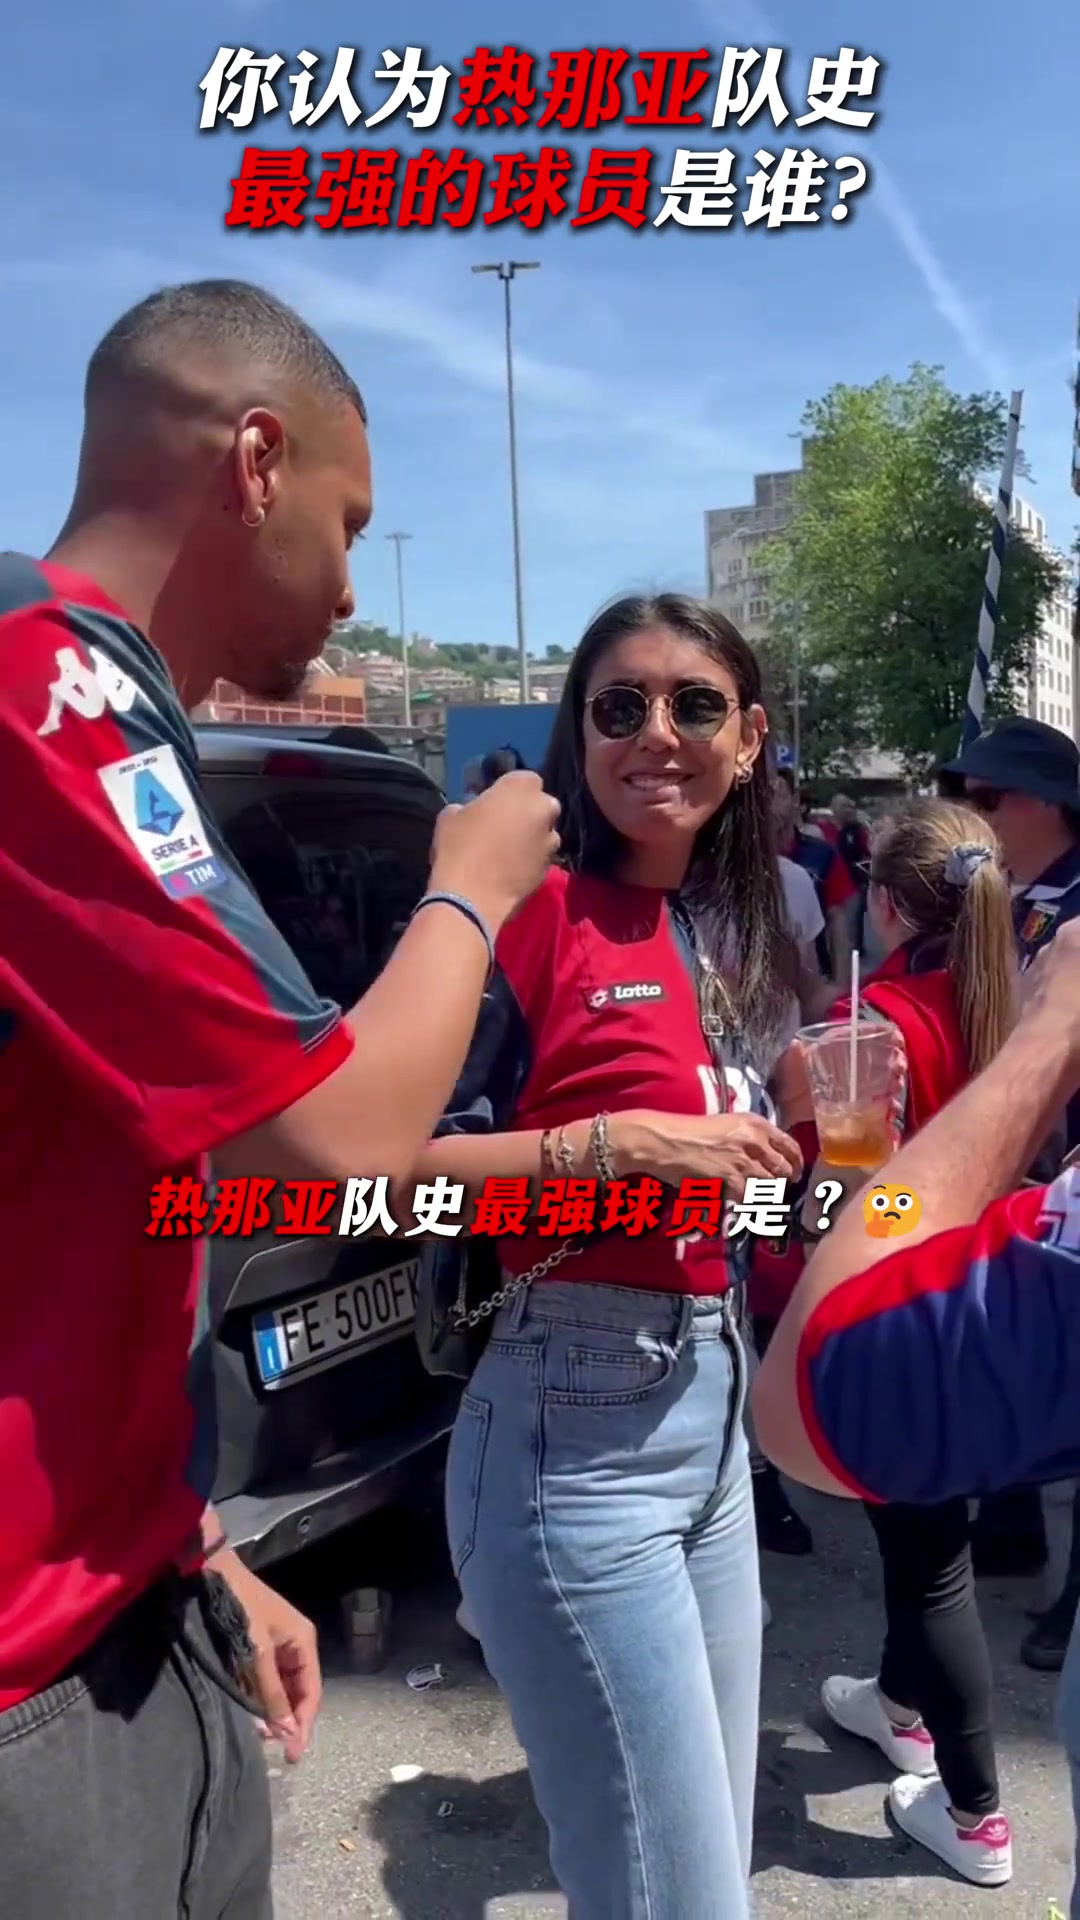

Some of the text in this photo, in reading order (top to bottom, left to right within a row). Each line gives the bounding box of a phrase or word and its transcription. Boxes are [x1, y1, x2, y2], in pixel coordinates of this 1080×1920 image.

[776, 745, 789, 762] P
[152, 834, 199, 860] SERIE A
[184, 864, 216, 885] TIM
[280, 1300, 326, 1363] FE
